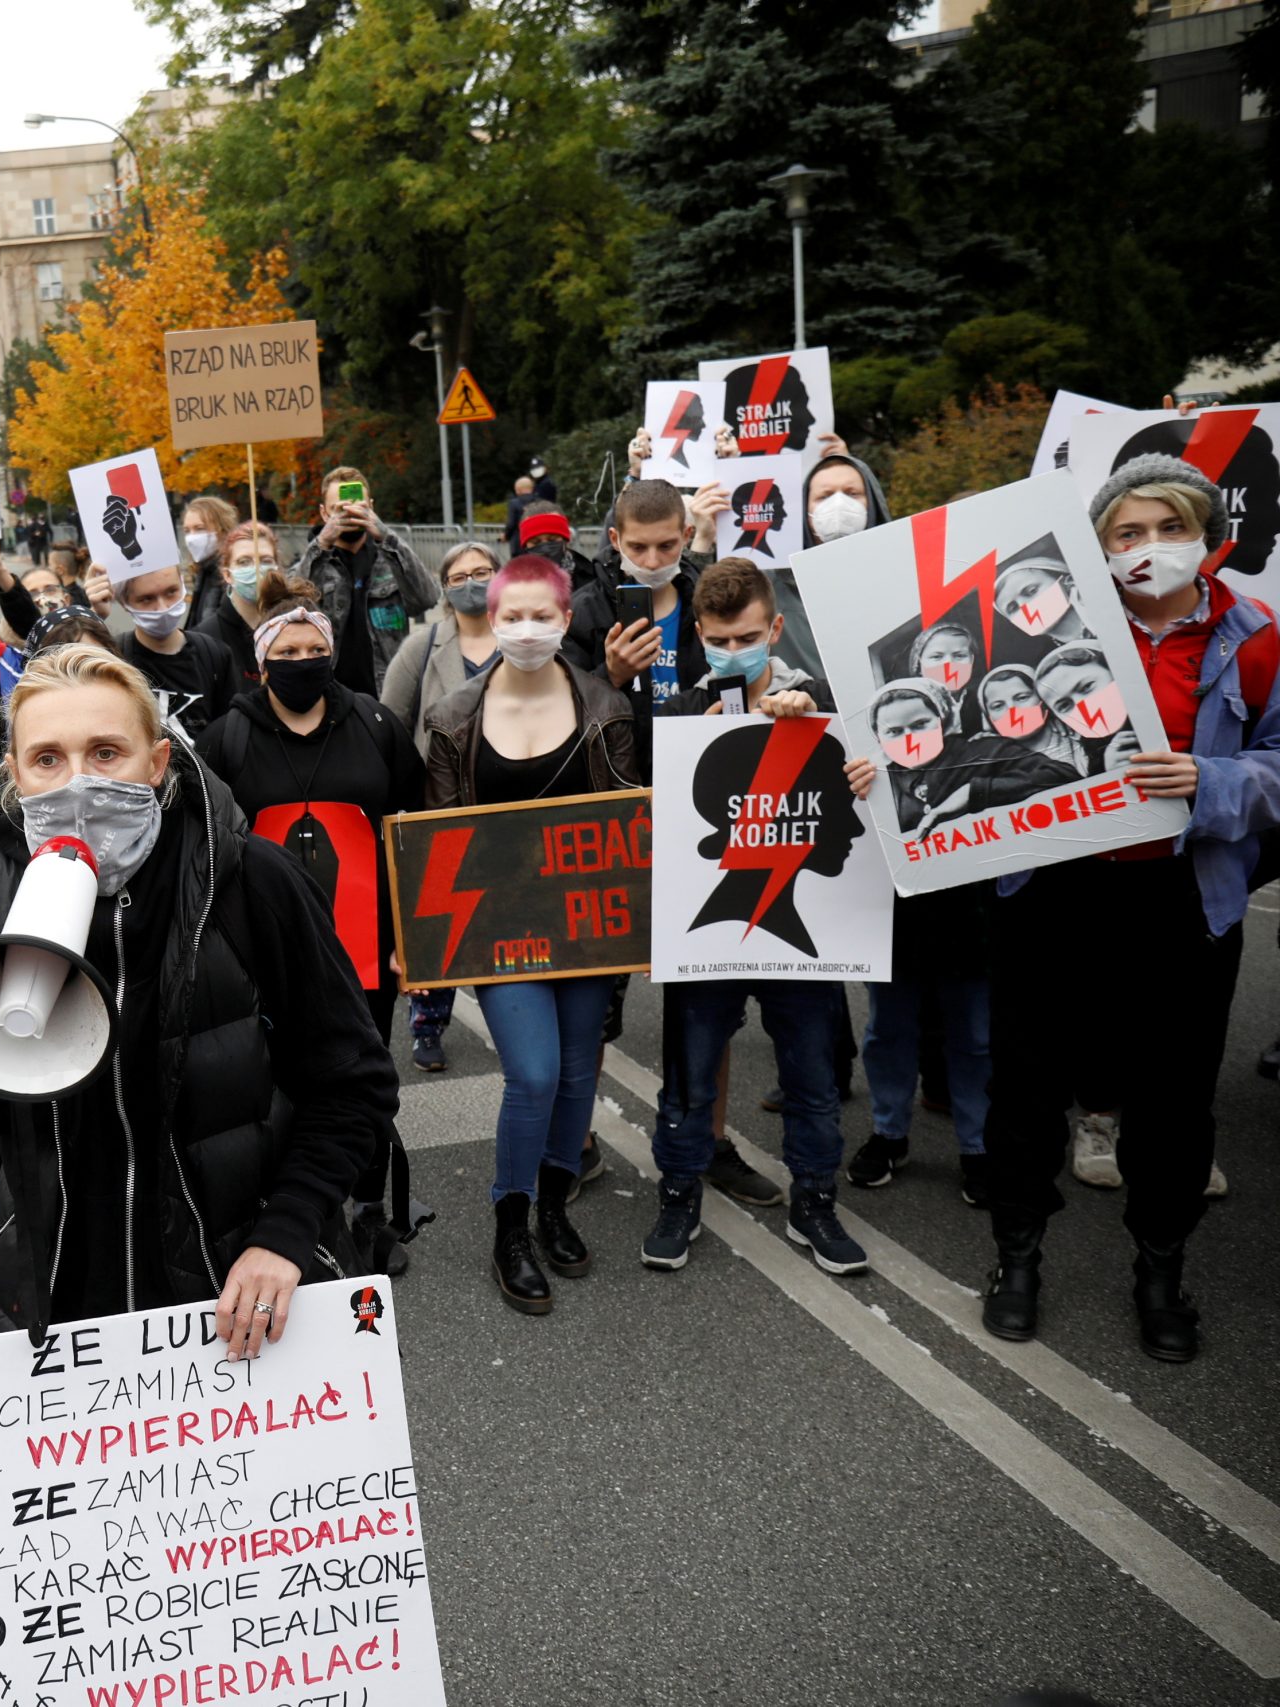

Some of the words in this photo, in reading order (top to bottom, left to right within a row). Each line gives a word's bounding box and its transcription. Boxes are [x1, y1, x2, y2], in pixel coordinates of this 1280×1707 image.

[170, 345, 224, 377] RZĄD
[230, 343, 256, 369] NA
[260, 339, 311, 367] BRUK
[175, 394, 227, 422] BRUK
[233, 391, 260, 414] NA
[265, 385, 314, 416] RZĄD
[736, 400, 793, 421] STRAJK
[738, 419, 792, 439] KOBIET
[742, 503, 775, 513] STRAJK
[743, 512, 774, 523] KOBIET
[728, 791, 823, 819] STRAJK
[540, 804, 653, 876] JEBAĆ
[729, 821, 820, 848] KOBIET
[904, 817, 1002, 862] STRAJK
[565, 887, 631, 941] PIS
[494, 930, 553, 974] OPÓR
[677, 964, 690, 974] NIE
[692, 964, 706, 973] DLA
[708, 963, 759, 973] ZAOSTRZENIA
[761, 962, 794, 972] USTAWY
[797, 962, 871, 974] ANTYABORCYJNEJ
[357, 1301, 376, 1309] STRAJK
[358, 1307, 377, 1315] KOBIET
[141, 1311, 245, 1354] LUD
[87, 1354, 261, 1414] ZAMIAST
[87, 1450, 255, 1510] ZAMIAST
[270, 1466, 418, 1522] CHCECIE
[14, 1551, 151, 1603] KARAĆ
[106, 1571, 260, 1628] ROBICIE
[33, 1624, 203, 1685] ZAMIAST
[232, 1594, 400, 1652] REALNIE
